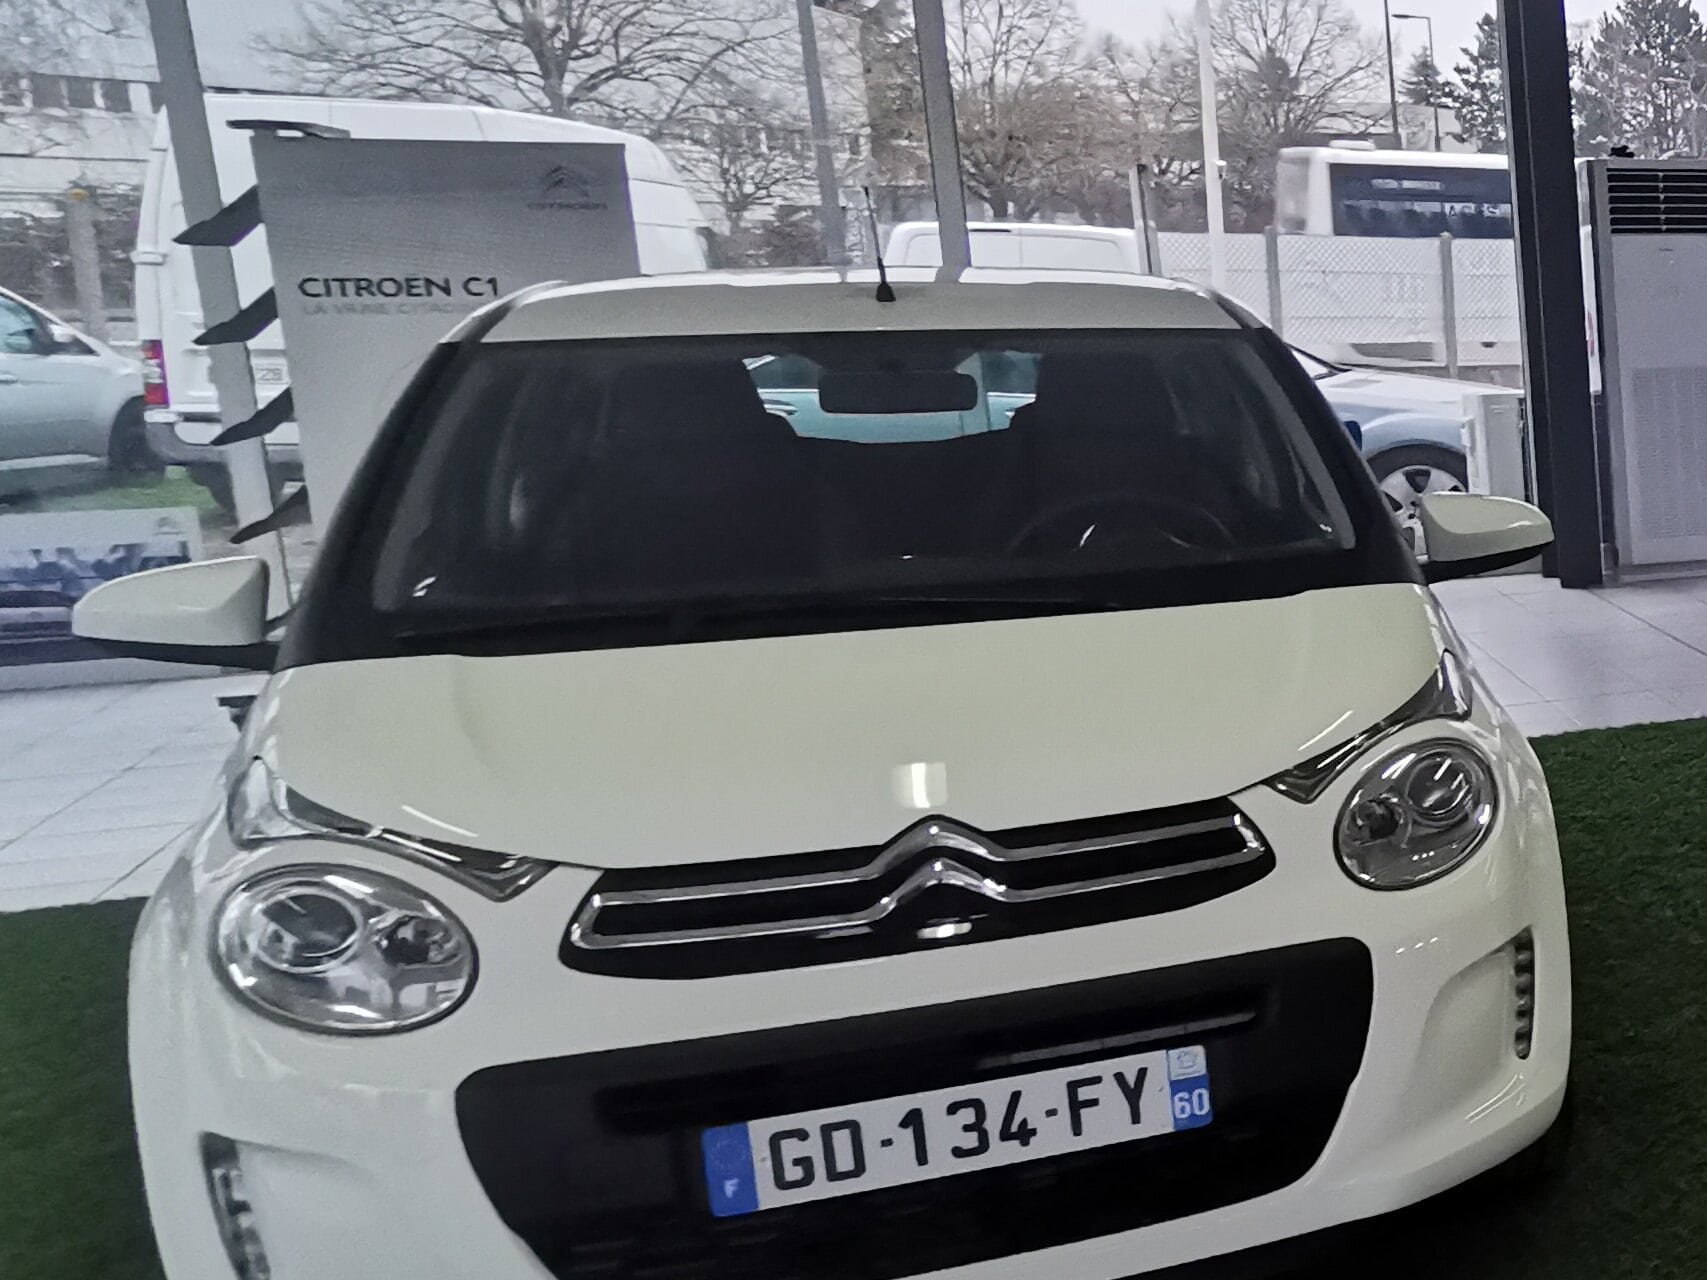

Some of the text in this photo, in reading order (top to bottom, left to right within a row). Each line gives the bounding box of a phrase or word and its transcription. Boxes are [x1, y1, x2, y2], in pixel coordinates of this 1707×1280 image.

[461, 276, 499, 297] C1
[1173, 1087, 1210, 1119] 60
[768, 1066, 1148, 1191] GD-134-FY
[724, 1178, 739, 1198] F
